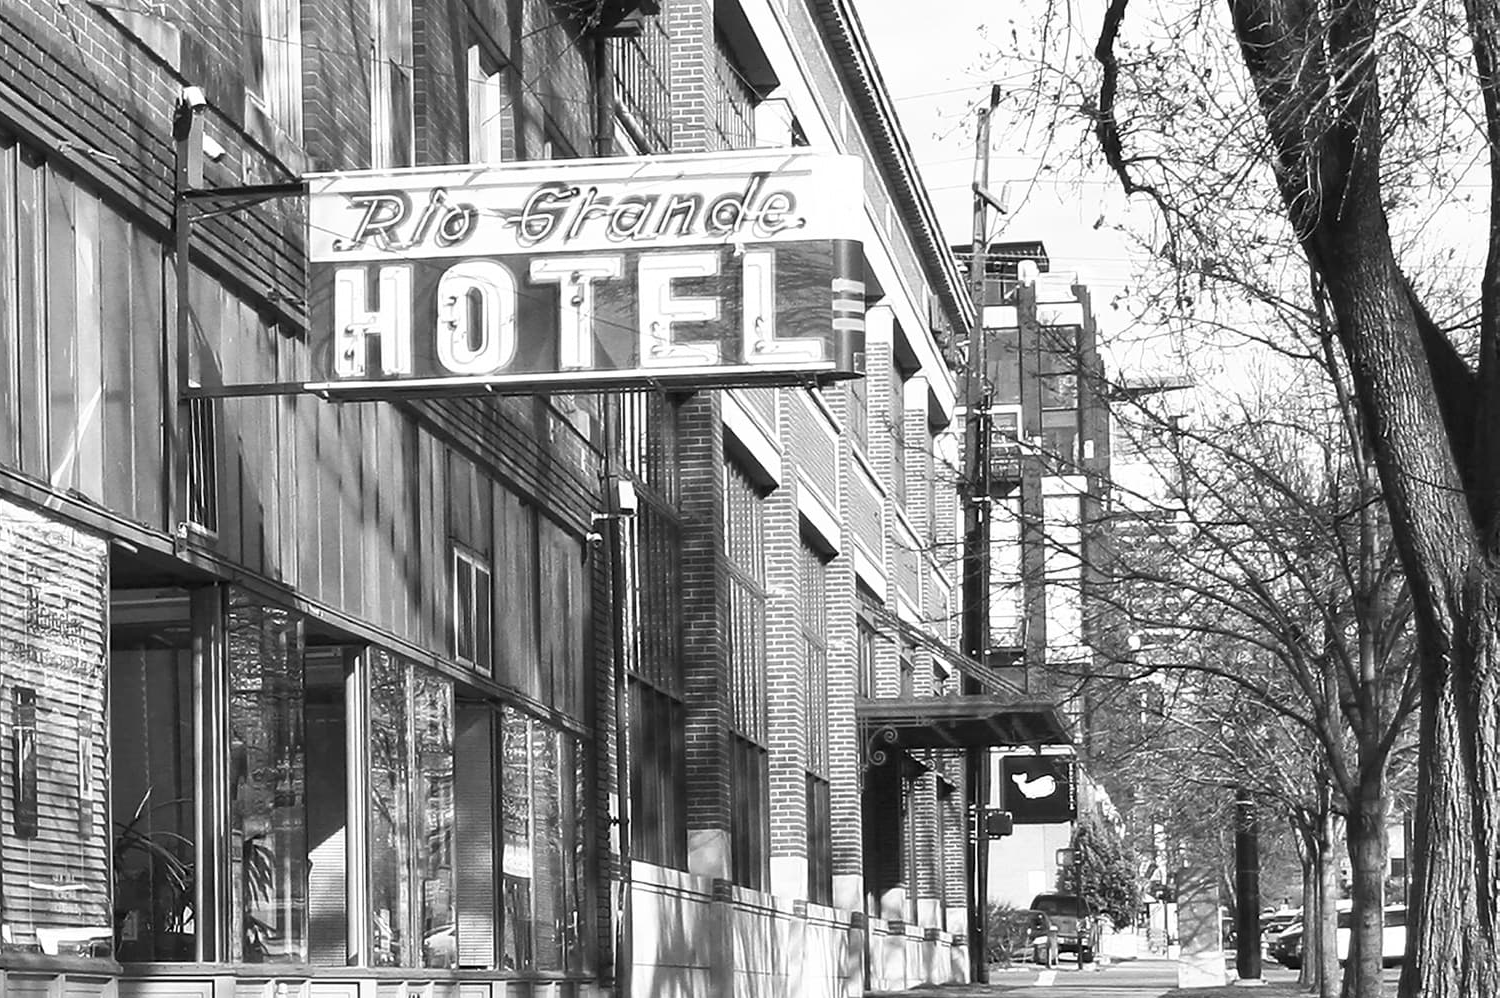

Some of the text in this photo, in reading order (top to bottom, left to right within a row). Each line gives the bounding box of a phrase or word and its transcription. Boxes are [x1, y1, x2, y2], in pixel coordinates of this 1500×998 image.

[331, 171, 807, 252] Rio Grande
[333, 250, 824, 376] HOTEL
